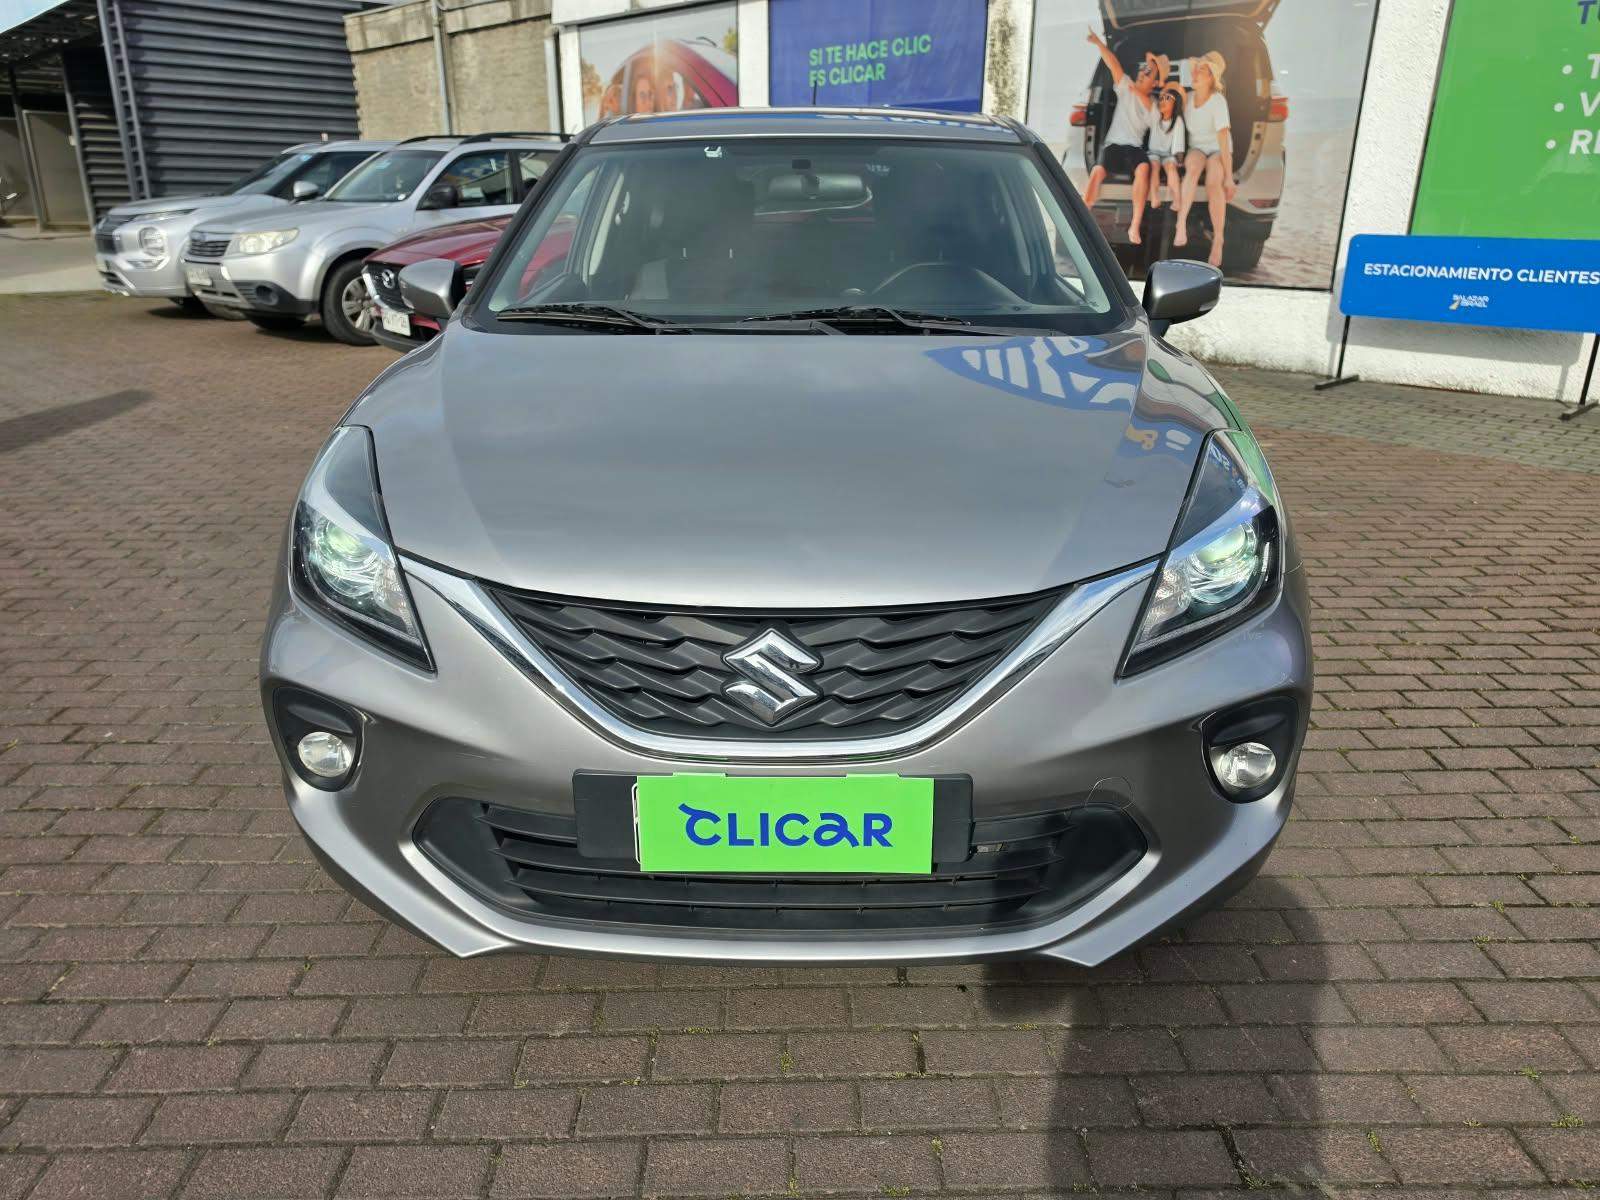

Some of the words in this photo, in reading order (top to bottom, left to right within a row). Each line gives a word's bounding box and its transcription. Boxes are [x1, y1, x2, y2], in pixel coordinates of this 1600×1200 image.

[1577, 0, 1600, 25] T
[809, 48, 823, 66] SI
[825, 46, 843, 64] TE
[846, 40, 889, 61] HACE
[892, 34, 932, 57] CLIC
[829, 63, 886, 85] CLICAR
[1364, 262, 1513, 282] ESTACIONAMIENTO
[1517, 268, 1600, 285] CLIENTES
